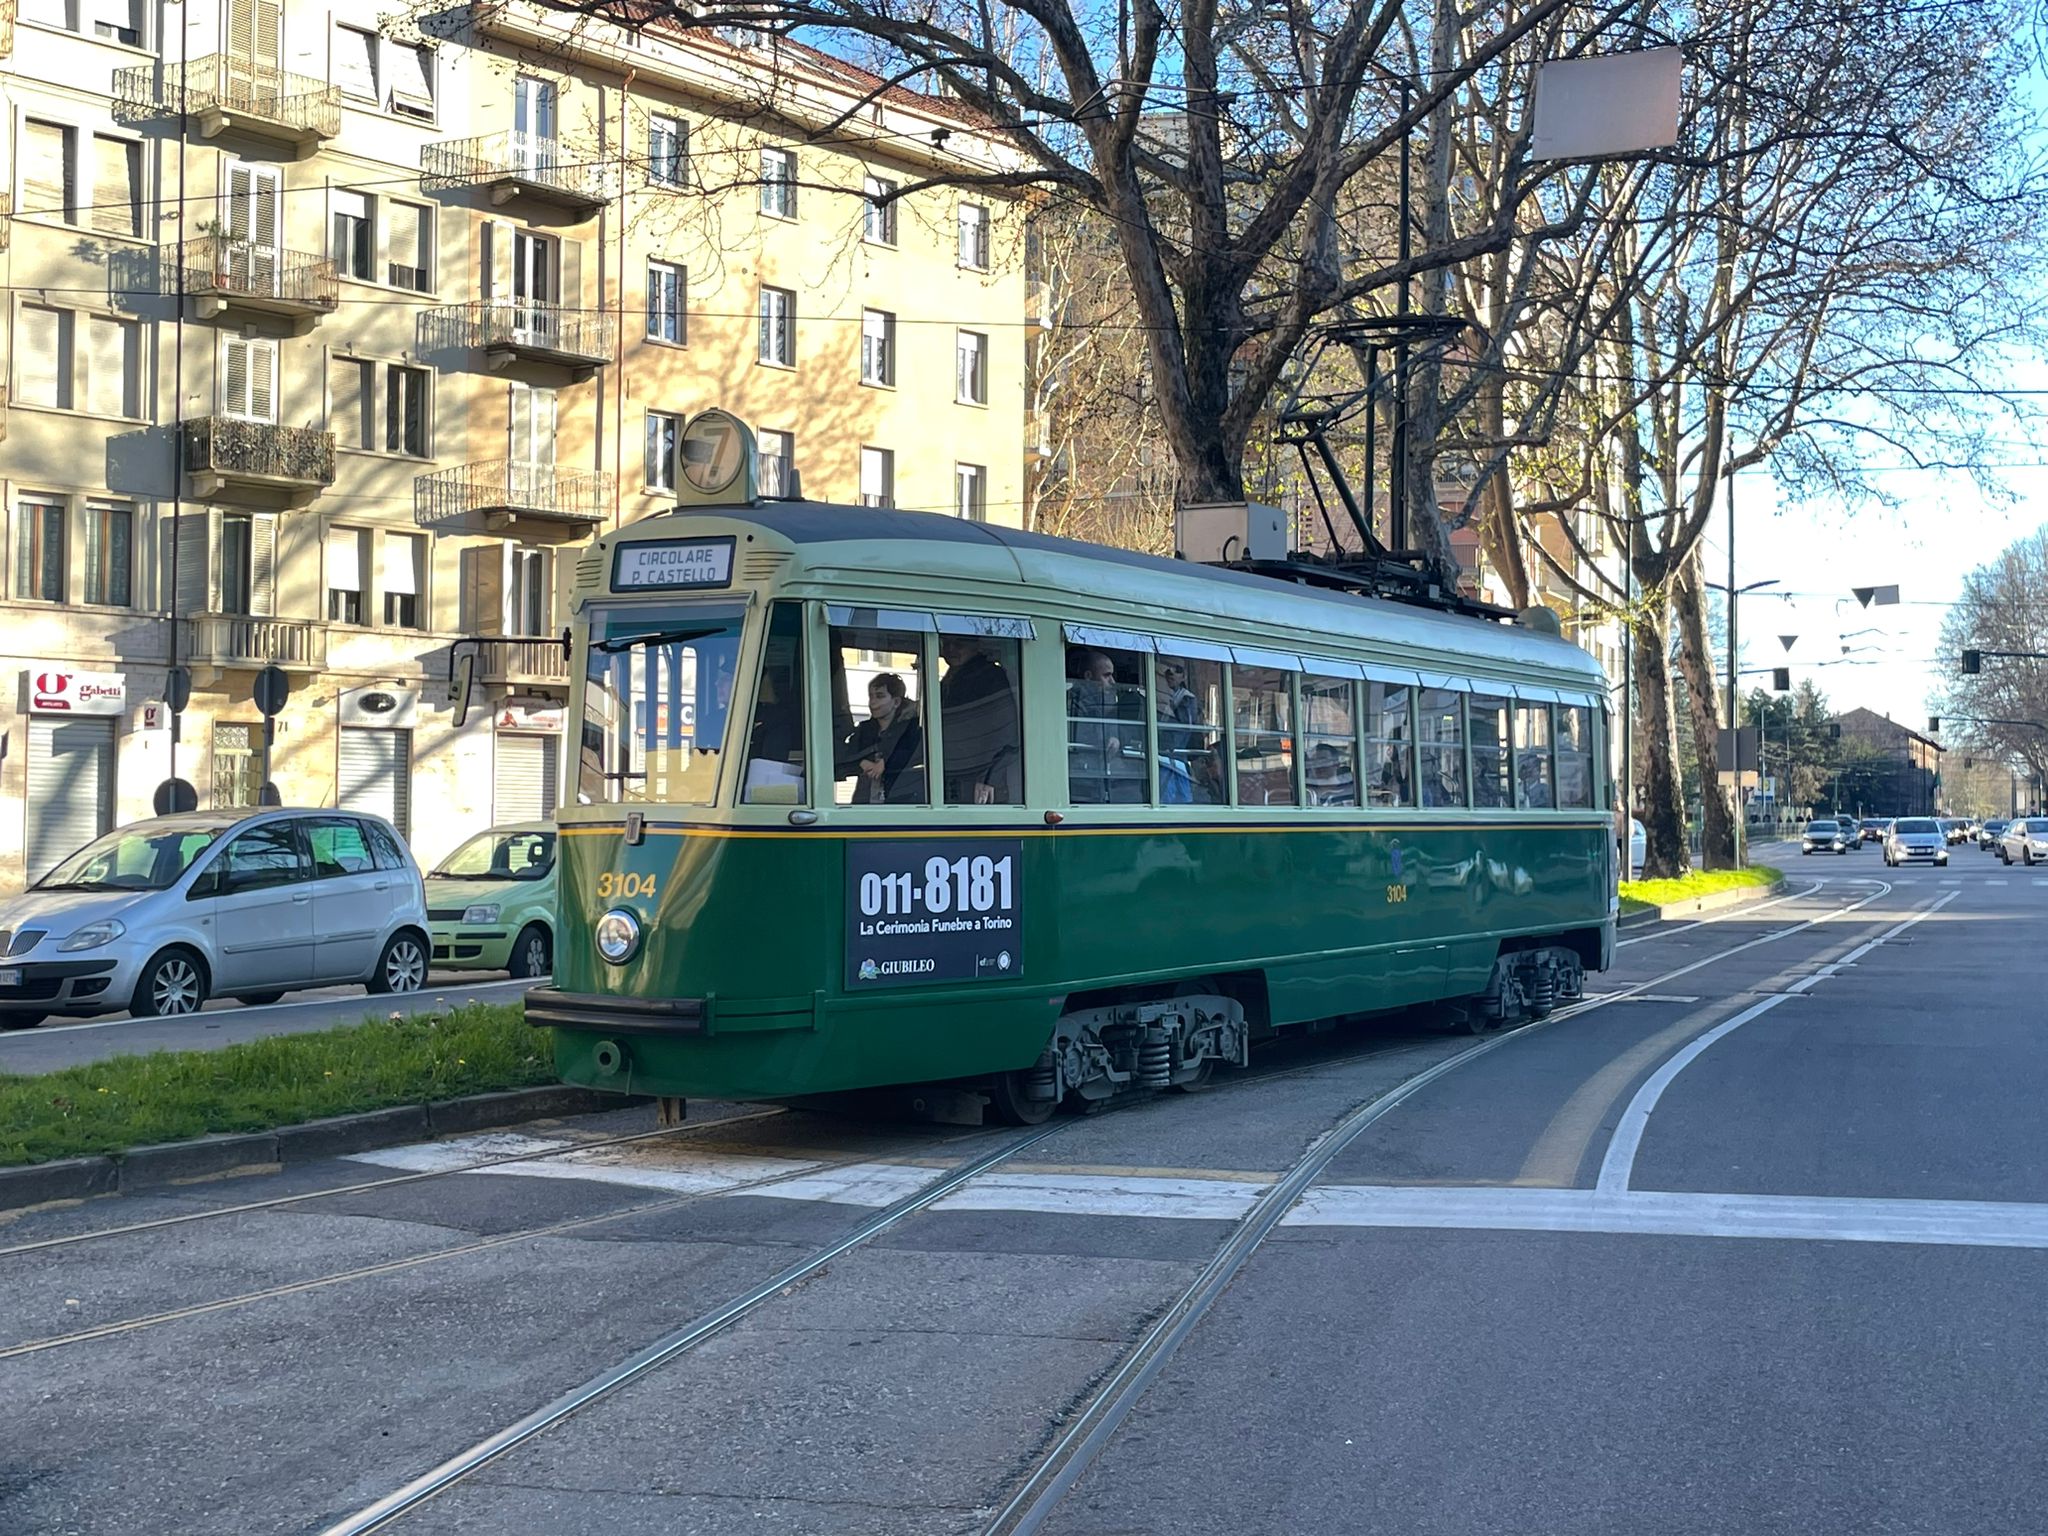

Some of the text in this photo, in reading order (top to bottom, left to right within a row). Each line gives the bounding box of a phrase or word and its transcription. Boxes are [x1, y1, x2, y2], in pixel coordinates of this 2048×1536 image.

[704, 427, 731, 477] 7
[638, 549, 713, 566] CIRCOLARE
[631, 567, 716, 585] P. CASTELLO
[79, 684, 121, 702] gabetti
[597, 872, 656, 898] 3104
[859, 855, 1013, 916] 011-8181
[1386, 884, 1407, 903] 3104
[860, 915, 1012, 936] La Cerimonia Funebre a Torino
[880, 958, 935, 975] GIUBILEO
